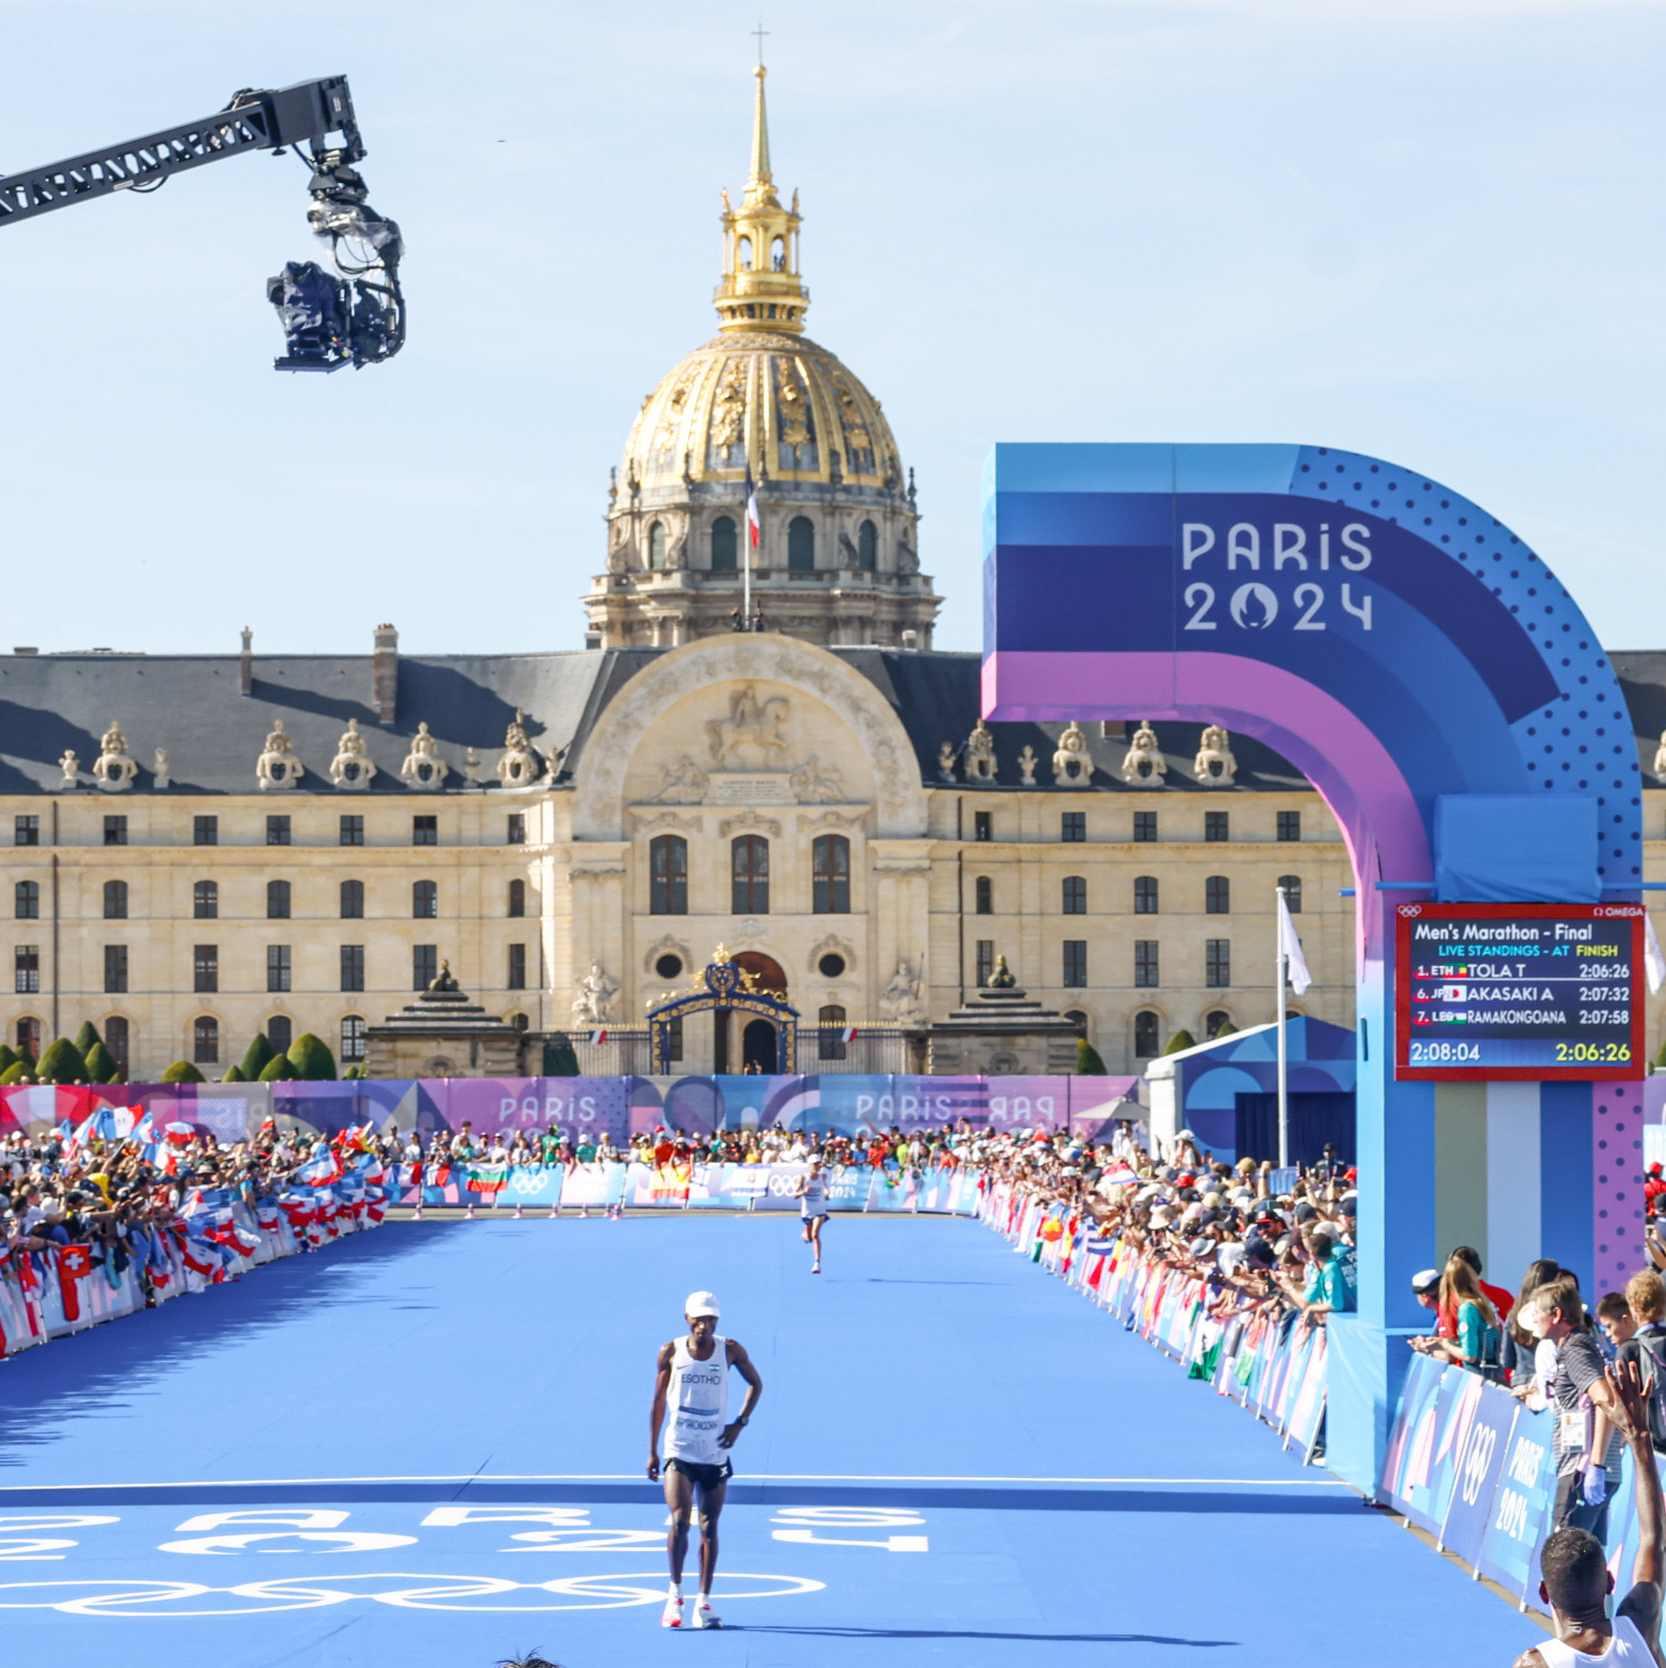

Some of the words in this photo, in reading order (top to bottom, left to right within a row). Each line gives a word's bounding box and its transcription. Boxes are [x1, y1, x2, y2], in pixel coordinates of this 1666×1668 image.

[1184, 582, 1372, 630] 2024
[1605, 907, 1643, 916] OMEGA
[1415, 924, 1459, 940] Men's
[1463, 924, 1539, 940] Marathon
[1555, 924, 1592, 940] Final
[1438, 945, 1465, 957] LIVE
[1468, 945, 1540, 957] STANDINGS
[1551, 945, 1570, 957] AT
[1576, 945, 1618, 957] FINISH
[1418, 966, 1429, 977] 1.
[1431, 966, 1454, 977] ETH
[1467, 964, 1513, 977] TOLA
[1515, 964, 1526, 977] T
[1580, 964, 1629, 978] 2:06:26
[1417, 988, 1429, 1000] 6.
[1467, 987, 1538, 1000] AKASAKI
[1541, 987, 1554, 1000] A
[1580, 987, 1629, 1001] 2:07:32
[1418, 1012, 1429, 1023] 7.
[1467, 1010, 1566, 1024] RAMAKONGOANA
[1580, 1010, 1629, 1024] 2:07:58
[1412, 1043, 1480, 1061] 2:08:04
[1556, 1043, 1631, 1061] 2:06:26
